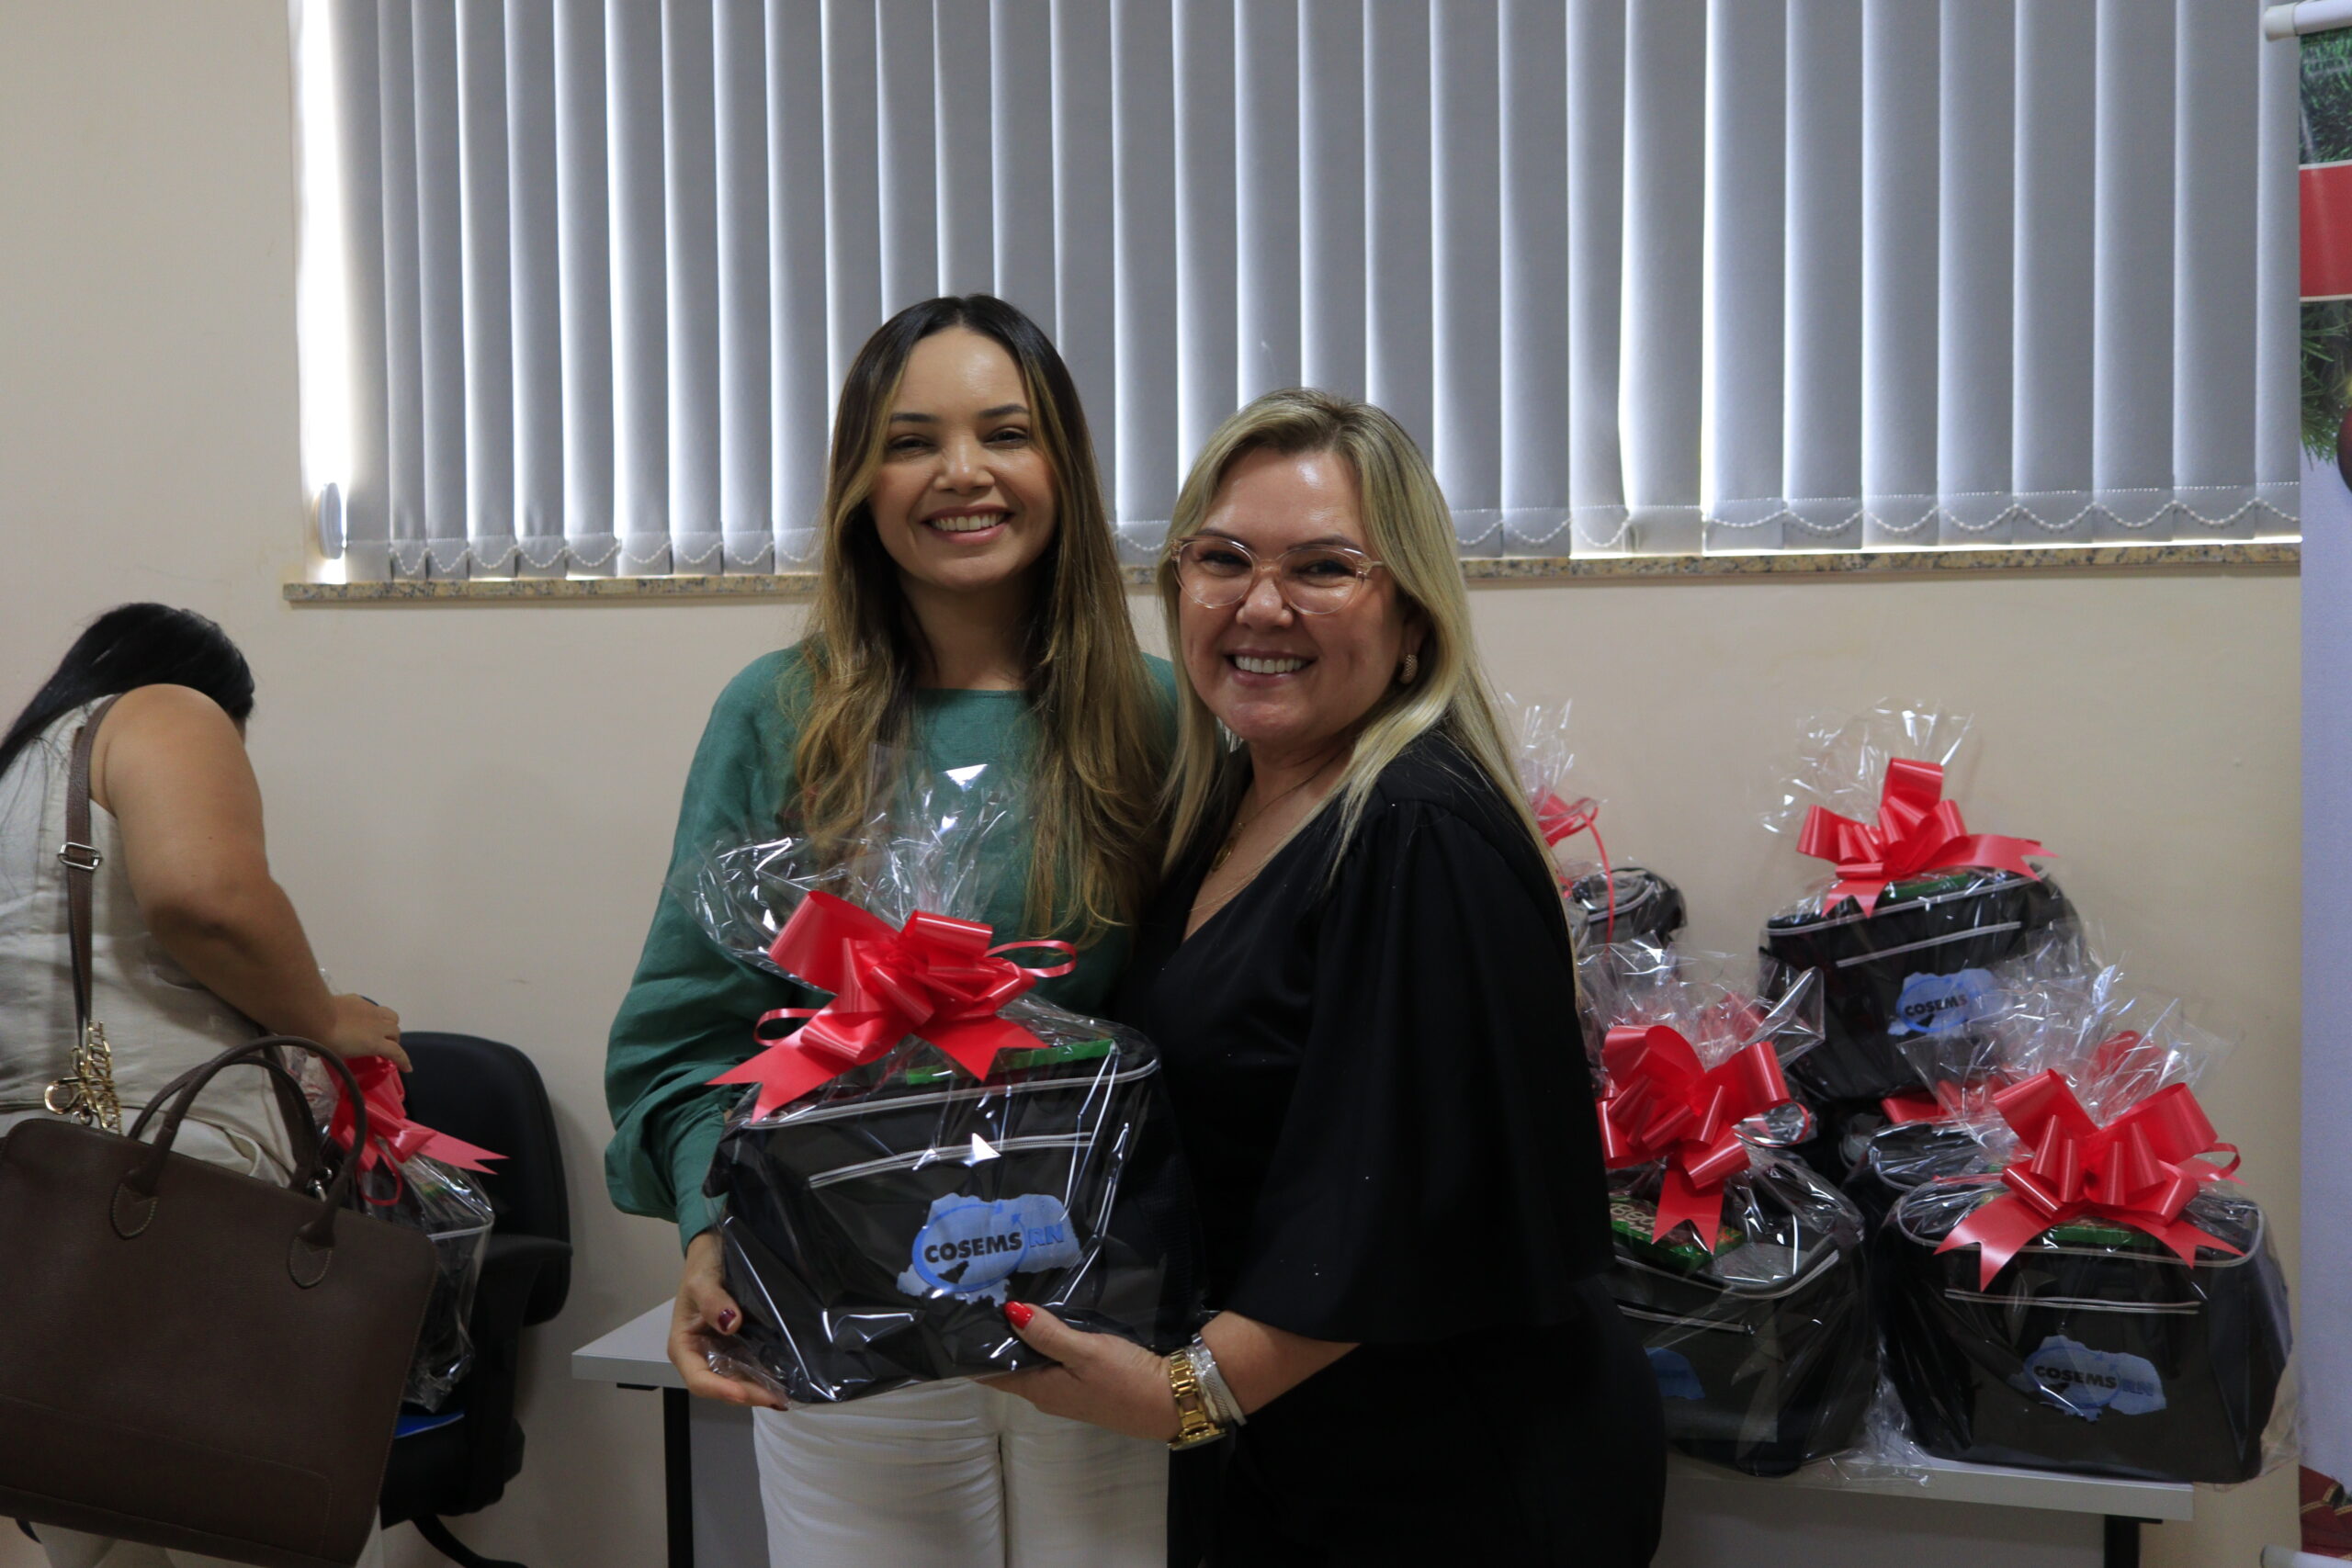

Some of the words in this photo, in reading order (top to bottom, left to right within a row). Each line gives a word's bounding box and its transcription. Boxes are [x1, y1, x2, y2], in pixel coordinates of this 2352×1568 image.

[1905, 994, 1967, 1016] COSEMS
[924, 1232, 1023, 1263] COSEMS
[1028, 1224, 1064, 1247] RN
[2034, 1366, 2117, 1389] COSEMS
